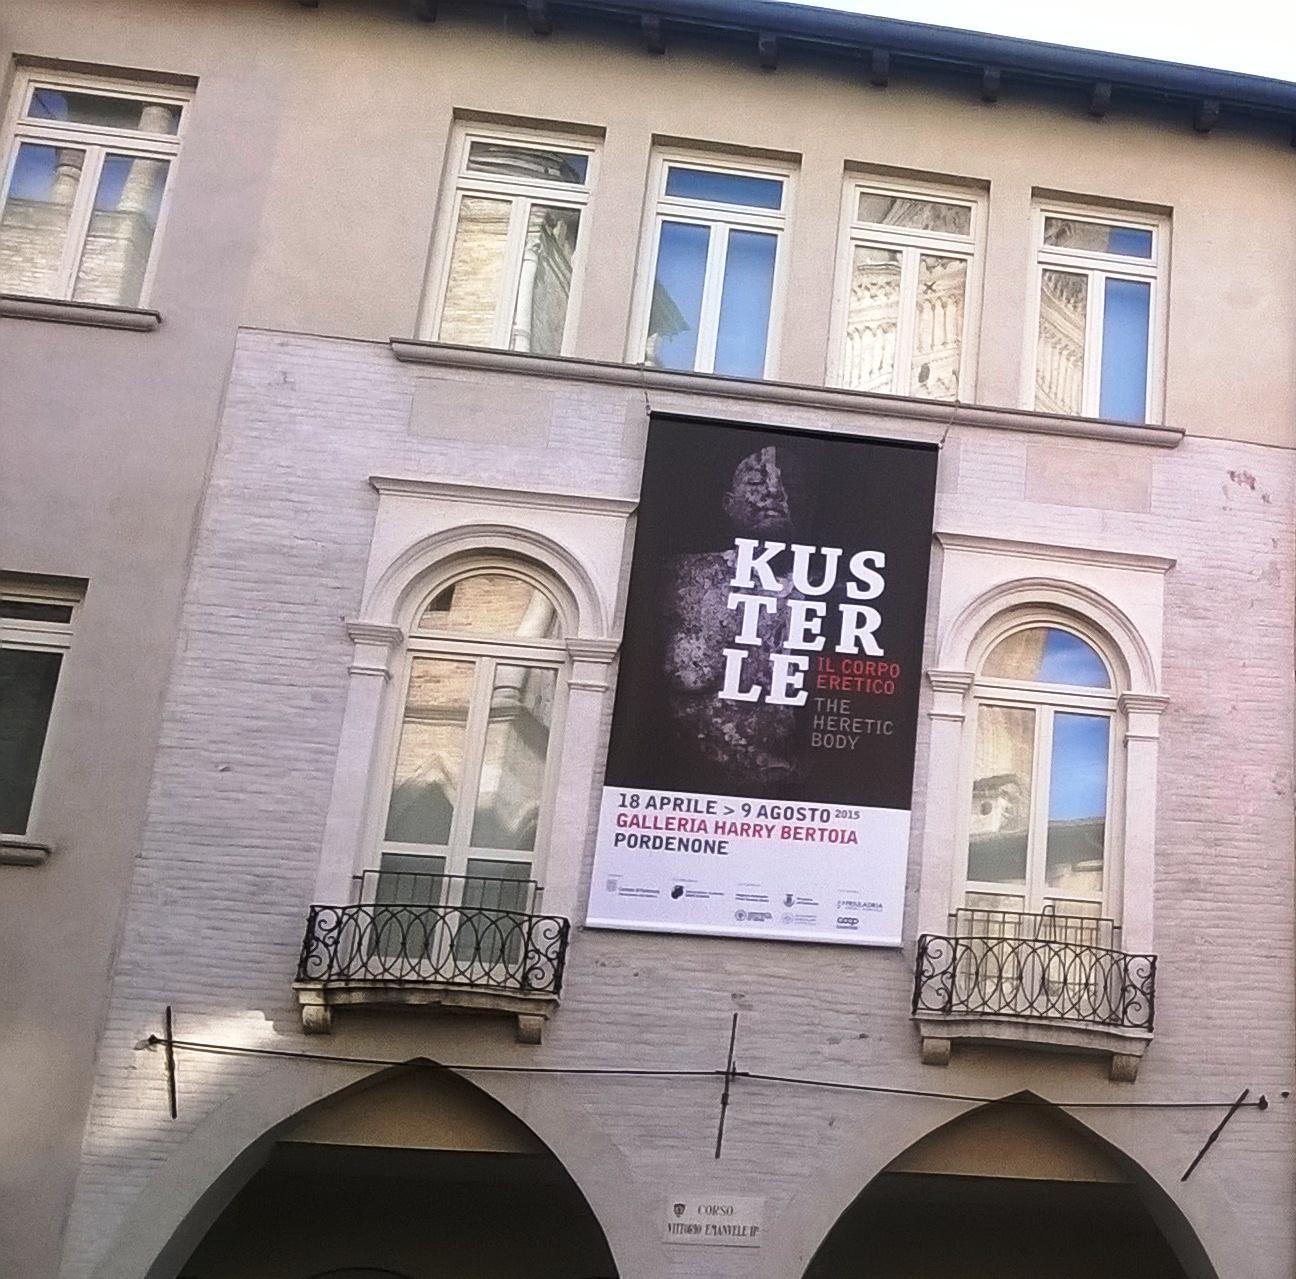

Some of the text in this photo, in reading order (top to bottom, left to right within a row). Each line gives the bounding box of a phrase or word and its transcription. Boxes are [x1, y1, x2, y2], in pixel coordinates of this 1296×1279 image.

[729, 537, 886, 600] KUS
[727, 592, 885, 656] TER
[717, 648, 810, 707] LE
[817, 656, 900, 678] IL CORPO
[816, 675, 895, 695] ERETICO
[815, 697, 851, 714] THE
[813, 715, 894, 735] HERETIC
[811, 732, 860, 750] BODY
[618, 793, 640, 809] 18
[645, 796, 718, 815] APRILE
[741, 802, 751, 818] 9
[756, 804, 831, 823] AGOSTO
[834, 809, 860, 820] 2015
[616, 812, 859, 845] GALLERIA HARRY BERTOIA
[614, 833, 729, 855] PORDENONE
[697, 1204, 734, 1216] CORSO
